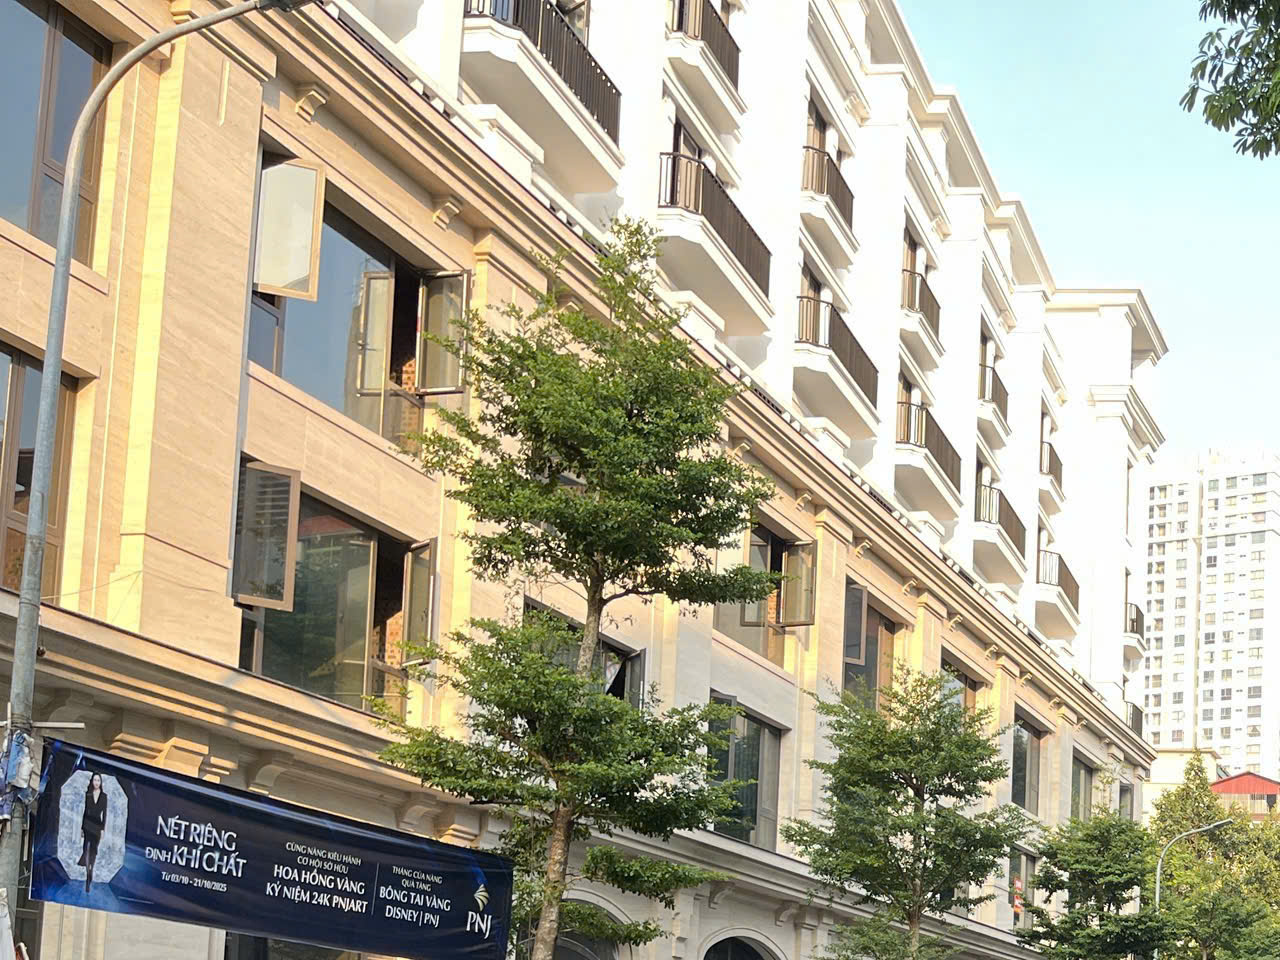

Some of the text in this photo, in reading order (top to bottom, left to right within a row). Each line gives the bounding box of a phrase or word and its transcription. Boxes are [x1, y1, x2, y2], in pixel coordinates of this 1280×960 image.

[157, 815, 237, 852] NÉT RIÊNG
[145, 845, 248, 878] ĐỊNH KHÍ CHẤT
[273, 864, 299, 882] HOA
[336, 877, 365, 895] VÀNG
[282, 885, 310, 904] NIỆM
[311, 891, 331, 907] 24K
[332, 895, 369, 914] PNJART
[409, 891, 424, 906] TAI
[425, 894, 451, 912] VÀNG
[385, 904, 419, 923] DISNEY
[424, 912, 440, 928] PNJ
[466, 910, 493, 940] PNJ
